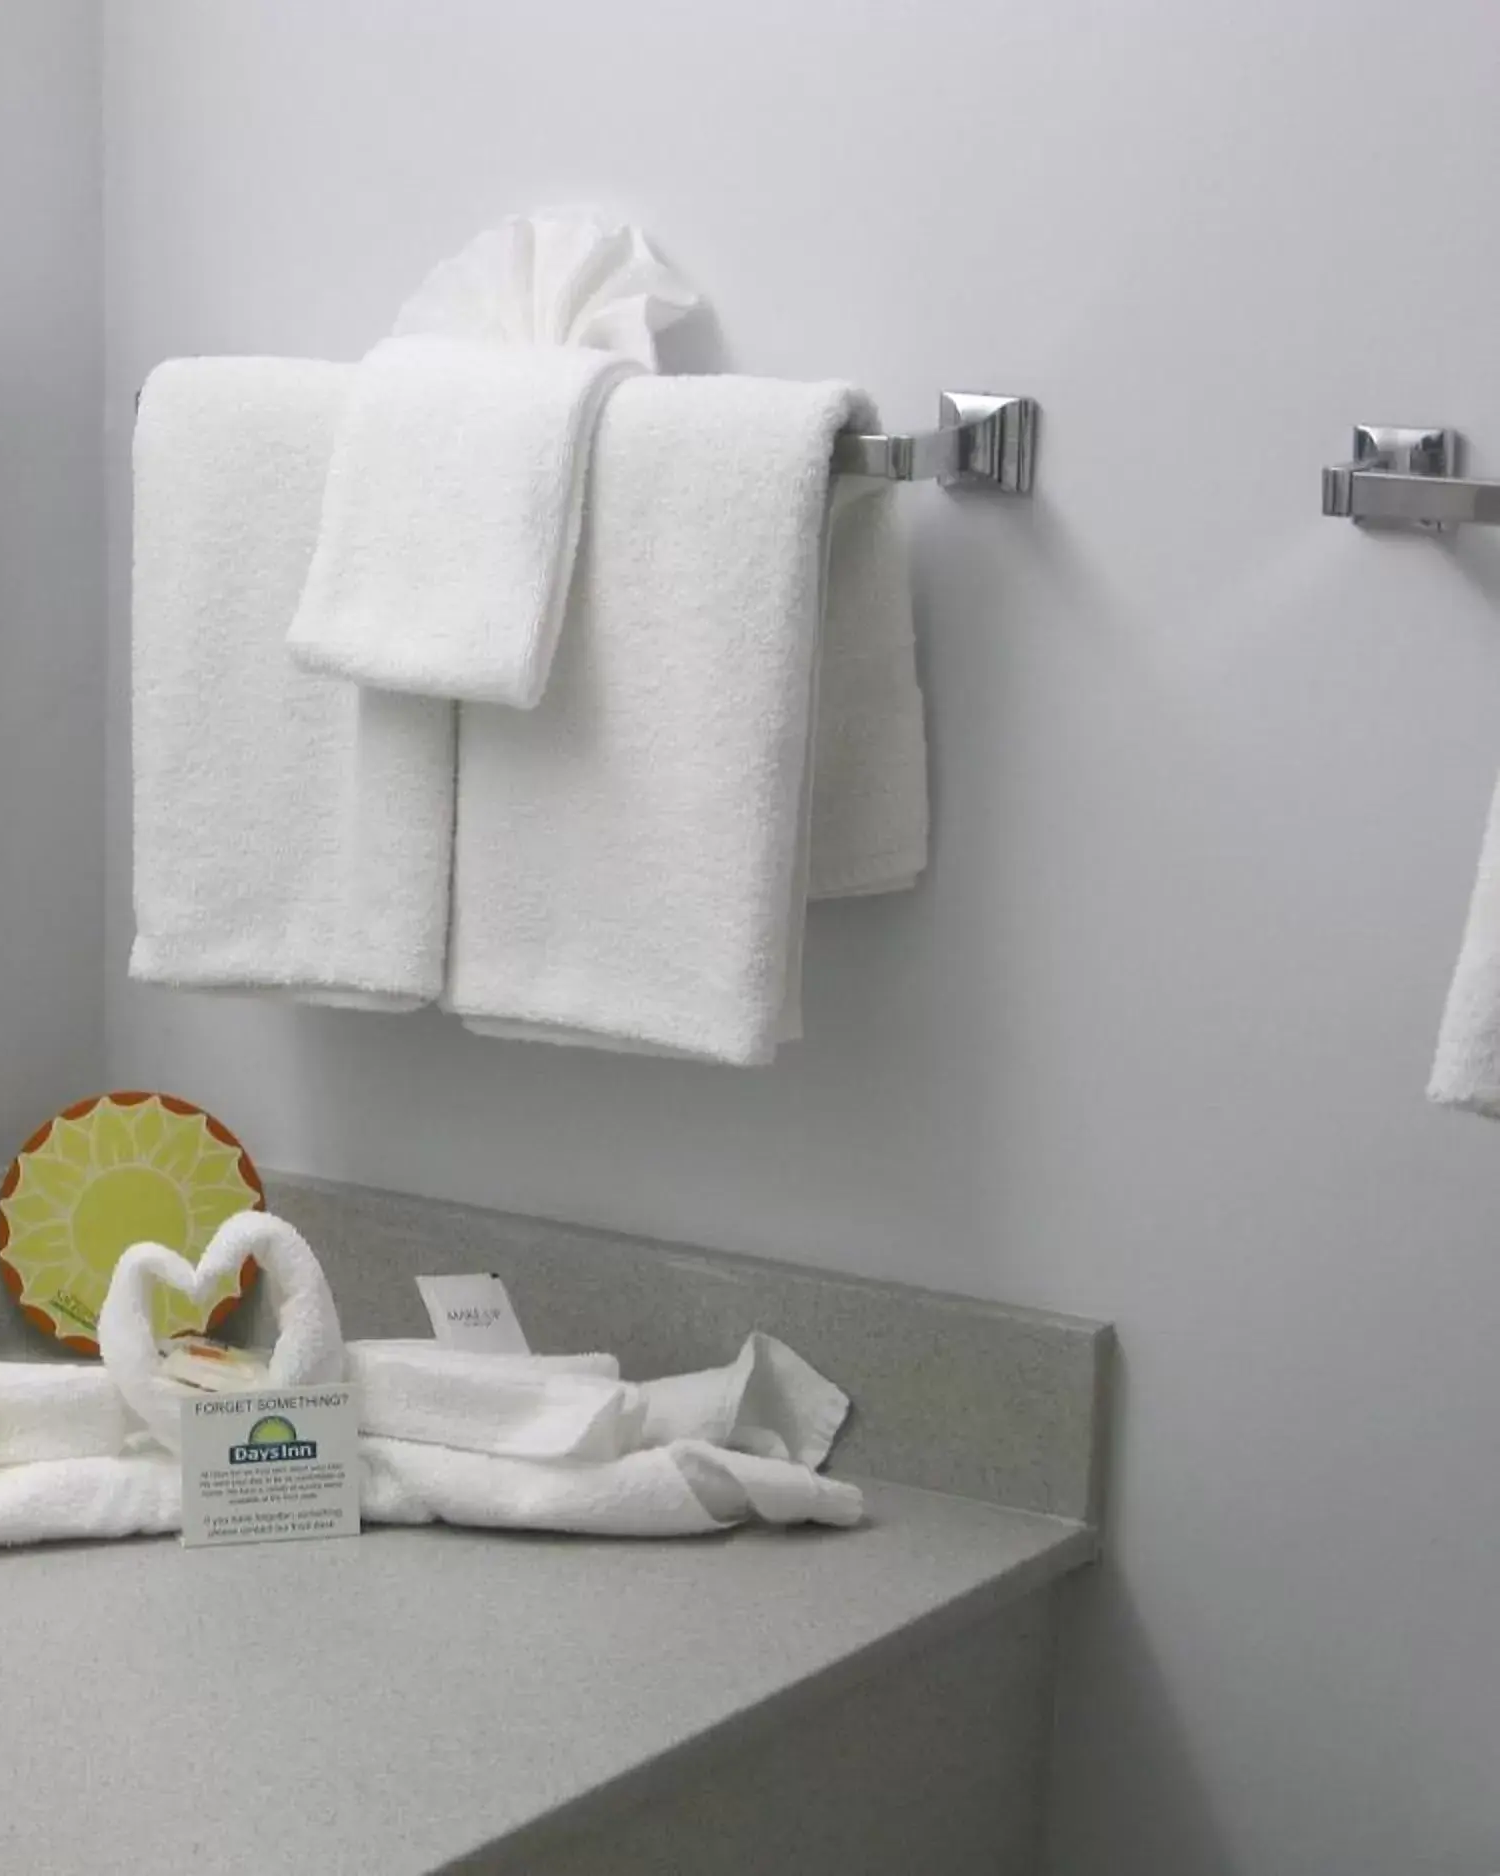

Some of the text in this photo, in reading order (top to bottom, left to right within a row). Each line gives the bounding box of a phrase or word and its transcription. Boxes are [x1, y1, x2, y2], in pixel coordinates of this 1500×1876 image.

[195, 1393, 350, 1415] FORGET SOMETHING?
[235, 1443, 312, 1462] Days Inn
